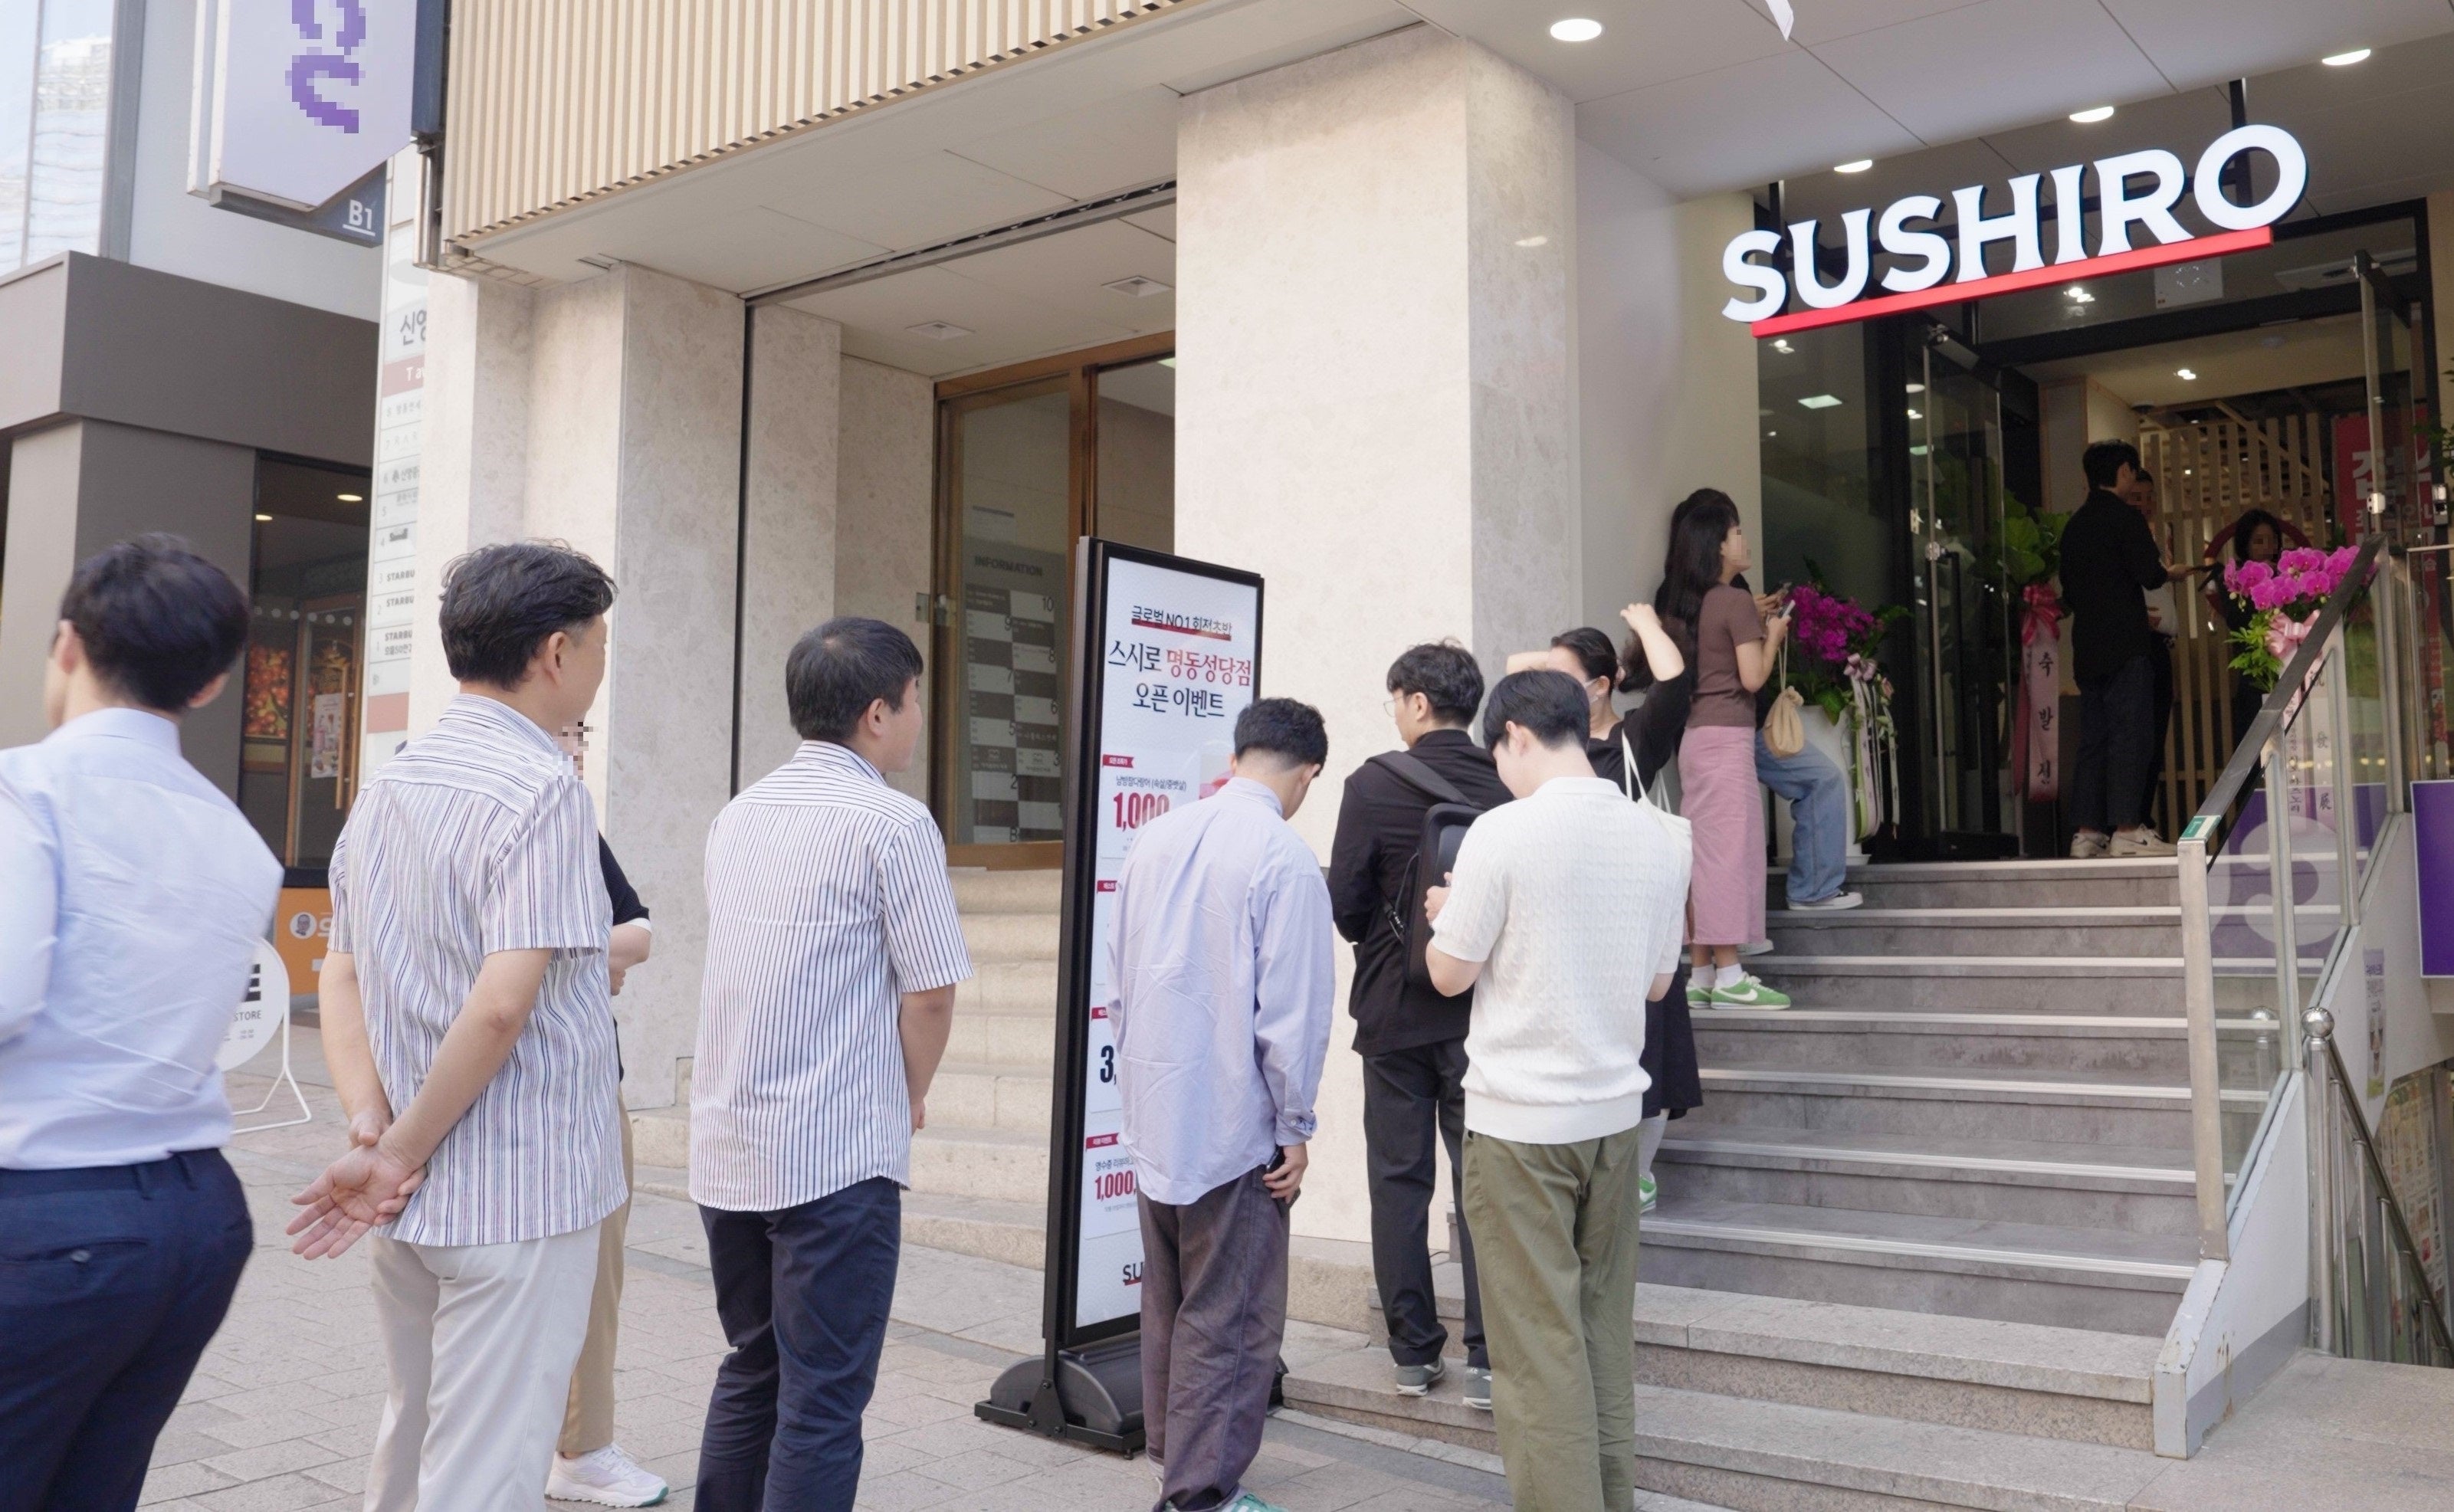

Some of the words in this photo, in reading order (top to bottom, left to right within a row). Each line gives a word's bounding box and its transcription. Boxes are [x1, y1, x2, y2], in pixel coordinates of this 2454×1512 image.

[348, 200, 373, 231] B1
[1721, 124, 2308, 324] SUSHIRO
[974, 555, 1043, 577] INFORMATION
[1042, 596, 1055, 612] 10
[1004, 615, 1012, 631] 9
[1108, 641, 1162, 673] 스시로
[1166, 649, 1252, 687] 명동성당점
[1051, 700, 1058, 715] 6
[1132, 683, 1169, 713] 오픈
[1173, 687, 1225, 717] 이벤트
[1010, 774, 1019, 789] 2
[233, 1010, 262, 1022] STORE
